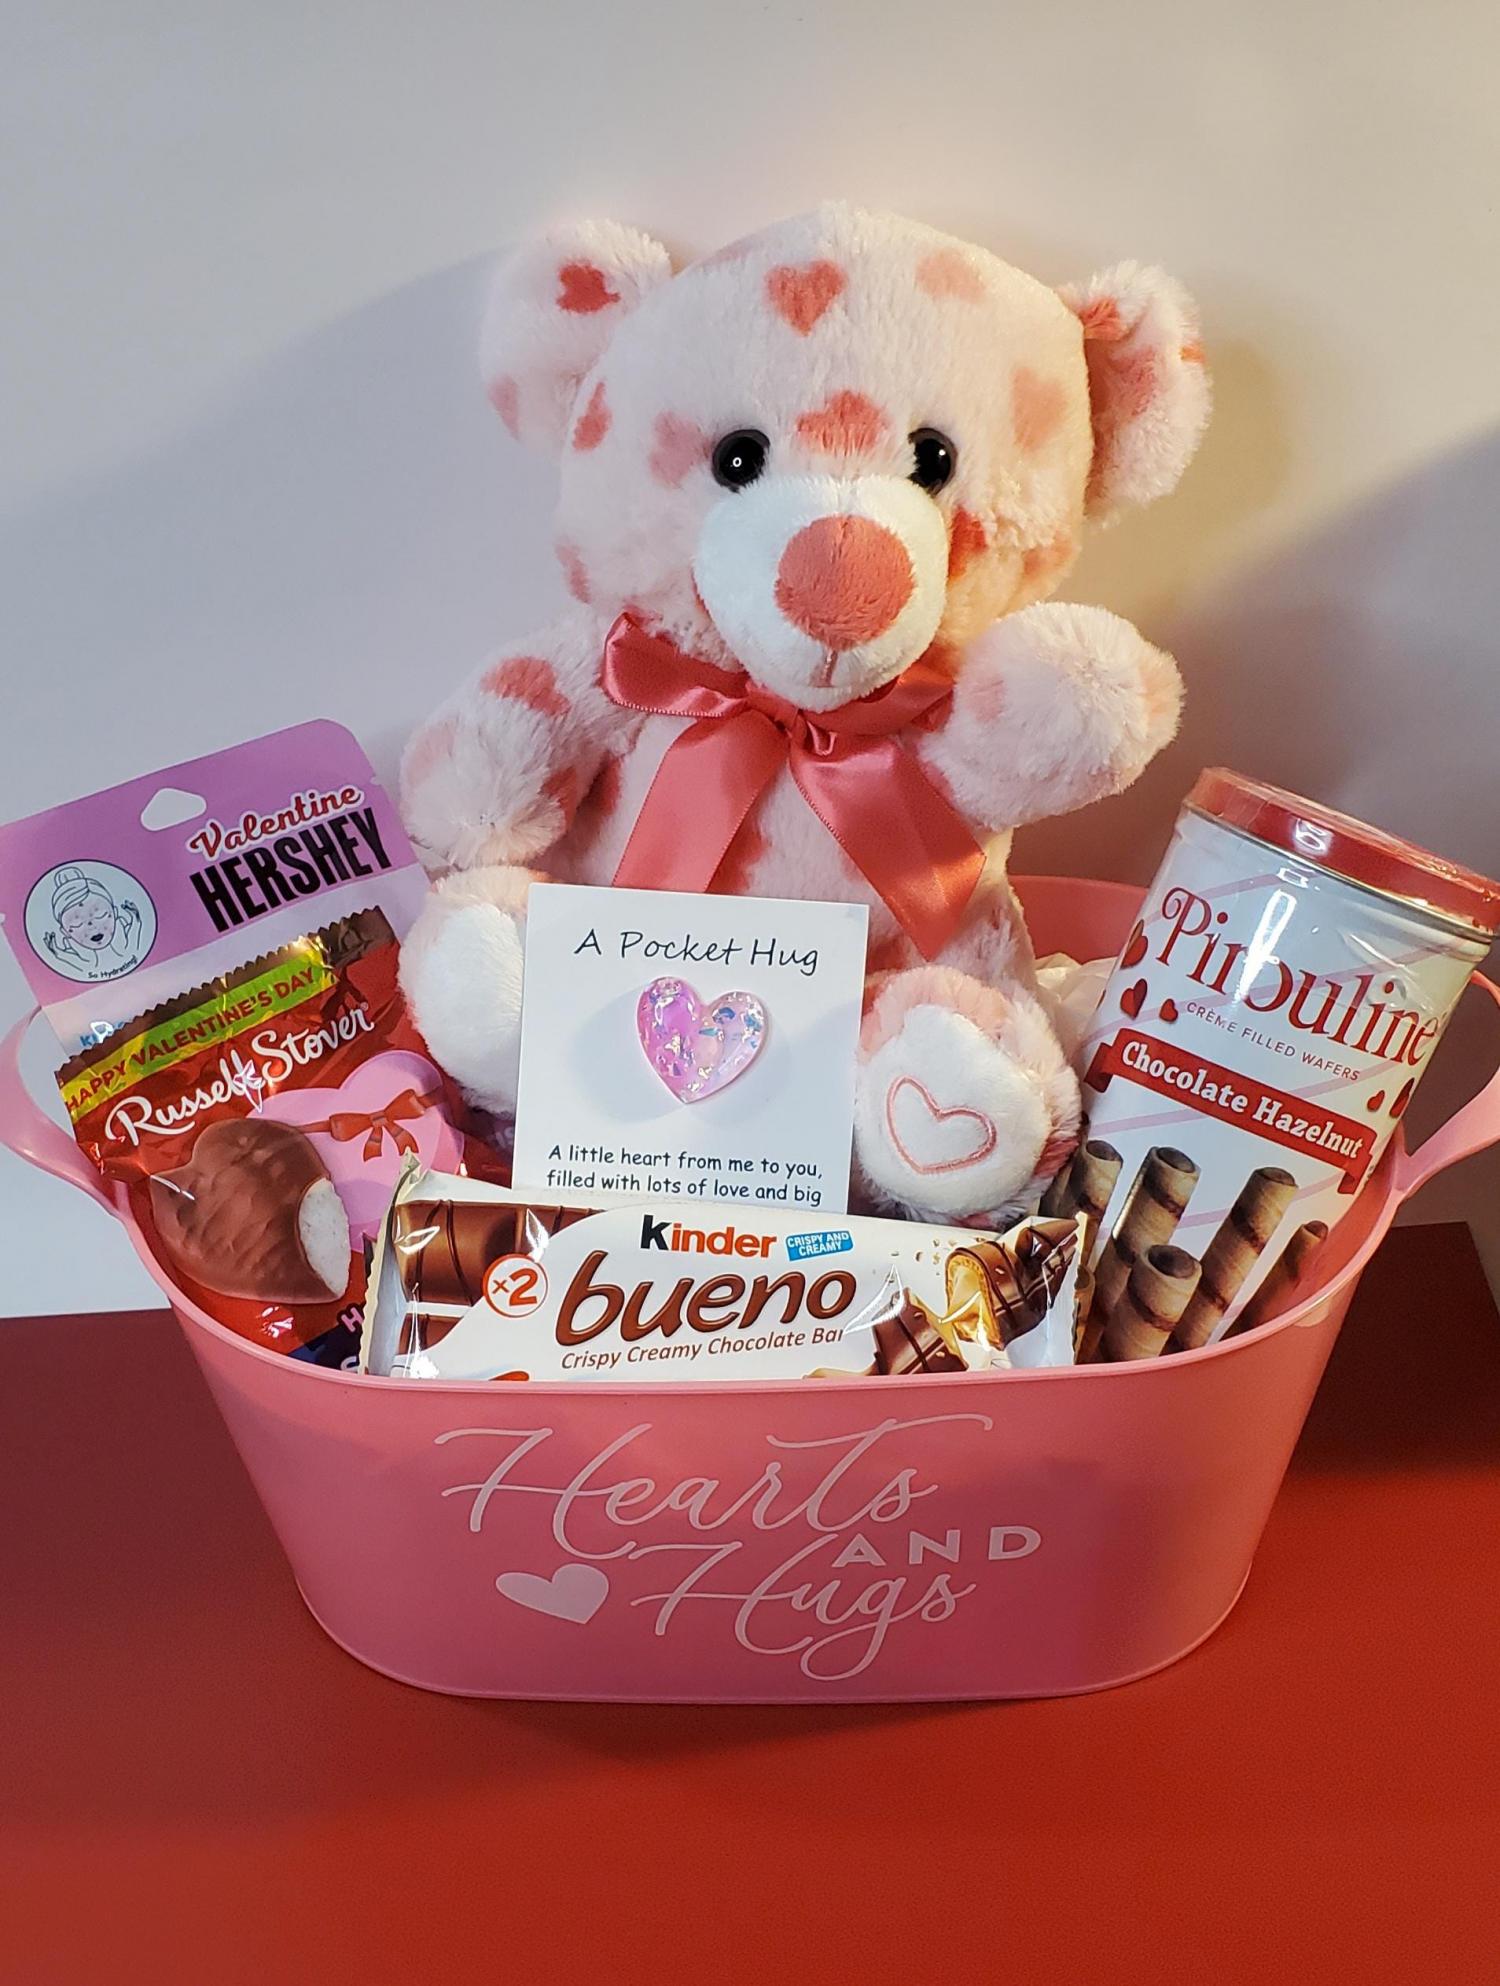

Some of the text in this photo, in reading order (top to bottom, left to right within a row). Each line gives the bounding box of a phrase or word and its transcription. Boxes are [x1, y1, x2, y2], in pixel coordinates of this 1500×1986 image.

[190, 785, 361, 858] Valentine
[190, 807, 391, 933] HERSHEY
[574, 928, 819, 976] A Pocket Hug
[1155, 887, 1439, 1066] Pirouline
[65, 1061, 127, 1110] HAPPY
[131, 992, 273, 1065] VALENTINE'S
[274, 967, 315, 999] DAY
[1241, 1028, 1296, 1057] FILLED
[1302, 1052, 1361, 1081] WAFERS
[1121, 1040, 1364, 1159] Chocolate Hazelnut
[547, 1169, 822, 1207] filled with lots of love and big
[548, 1145, 823, 1180] A little heart from me to you,
[787, 1232, 849, 1248] CRISPY AND
[799, 1241, 842, 1256] CREAMY
[555, 1249, 857, 1347] bueno
[561, 1327, 845, 1371] Crispy Creamy Chocolate Bar
[434, 1414, 993, 1559] Hearts
[832, 1526, 1041, 1568] AND
[627, 1533, 977, 1681] Hugs
